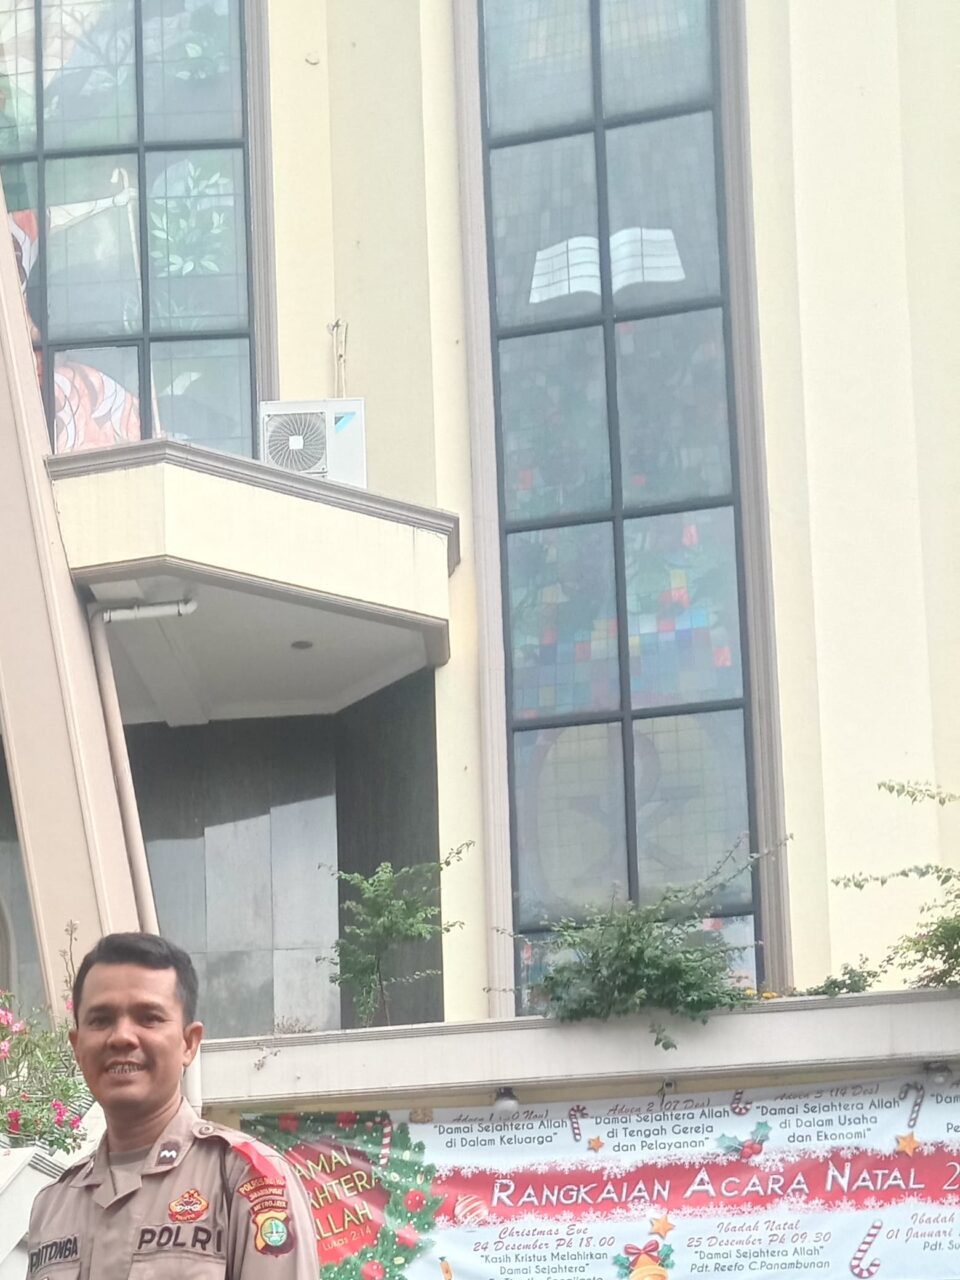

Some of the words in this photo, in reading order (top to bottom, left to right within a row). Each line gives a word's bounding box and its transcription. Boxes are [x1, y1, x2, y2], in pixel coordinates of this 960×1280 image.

[803, 1101, 864, 1114] Sejahtera
[868, 1098, 900, 1109] Allah
[636, 1110, 695, 1124] Sejahtera
[699, 1108, 730, 1119] Allah
[779, 1119, 791, 1129] di
[795, 1117, 834, 1128] Dalam
[838, 1115, 878, 1126] Usaha
[477, 1121, 534, 1133] Sejahtera
[538, 1119, 568, 1130] Allah
[607, 1128, 618, 1139] di
[622, 1126, 667, 1138] Tengah
[671, 1124, 714, 1136] Gereja
[445, 1138, 456, 1148] di
[461, 1136, 496, 1147] Dalam
[787, 1133, 812, 1144] dan
[612, 1142, 636, 1153] dan
[291, 1145, 352, 1180] AMAI
[491, 1179, 671, 1207] RANGKAIAN
[683, 1167, 809, 1197] ACARA
[826, 1161, 925, 1193] NATAL
[316, 1201, 373, 1240] LLAH
[911, 1212, 955, 1225] Ibadah
[498, 1226, 559, 1240] Christmas
[566, 1224, 589, 1236] Eve
[717, 1221, 759, 1233] Ibadah
[763, 1219, 800, 1231] Natal
[137, 1225, 223, 1253] POLRI
[687, 1237, 703, 1248] 25
[707, 1235, 762, 1247] Desember
[768, 1233, 786, 1246] Pk
[905, 1227, 953, 1244] Januari
[473, 1241, 489, 1252] 24
[494, 1239, 549, 1251] Desember
[555, 1237, 573, 1250] Pk
[578, 1236, 616, 1248] 18.00
[514, 1252, 547, 1263] Kristus
[551, 1251, 608, 1261] Melahirkan
[736, 1248, 788, 1260] Sejahtera
[500, 1265, 531, 1275] Damai
[690, 1263, 711, 1273] Pdt.
